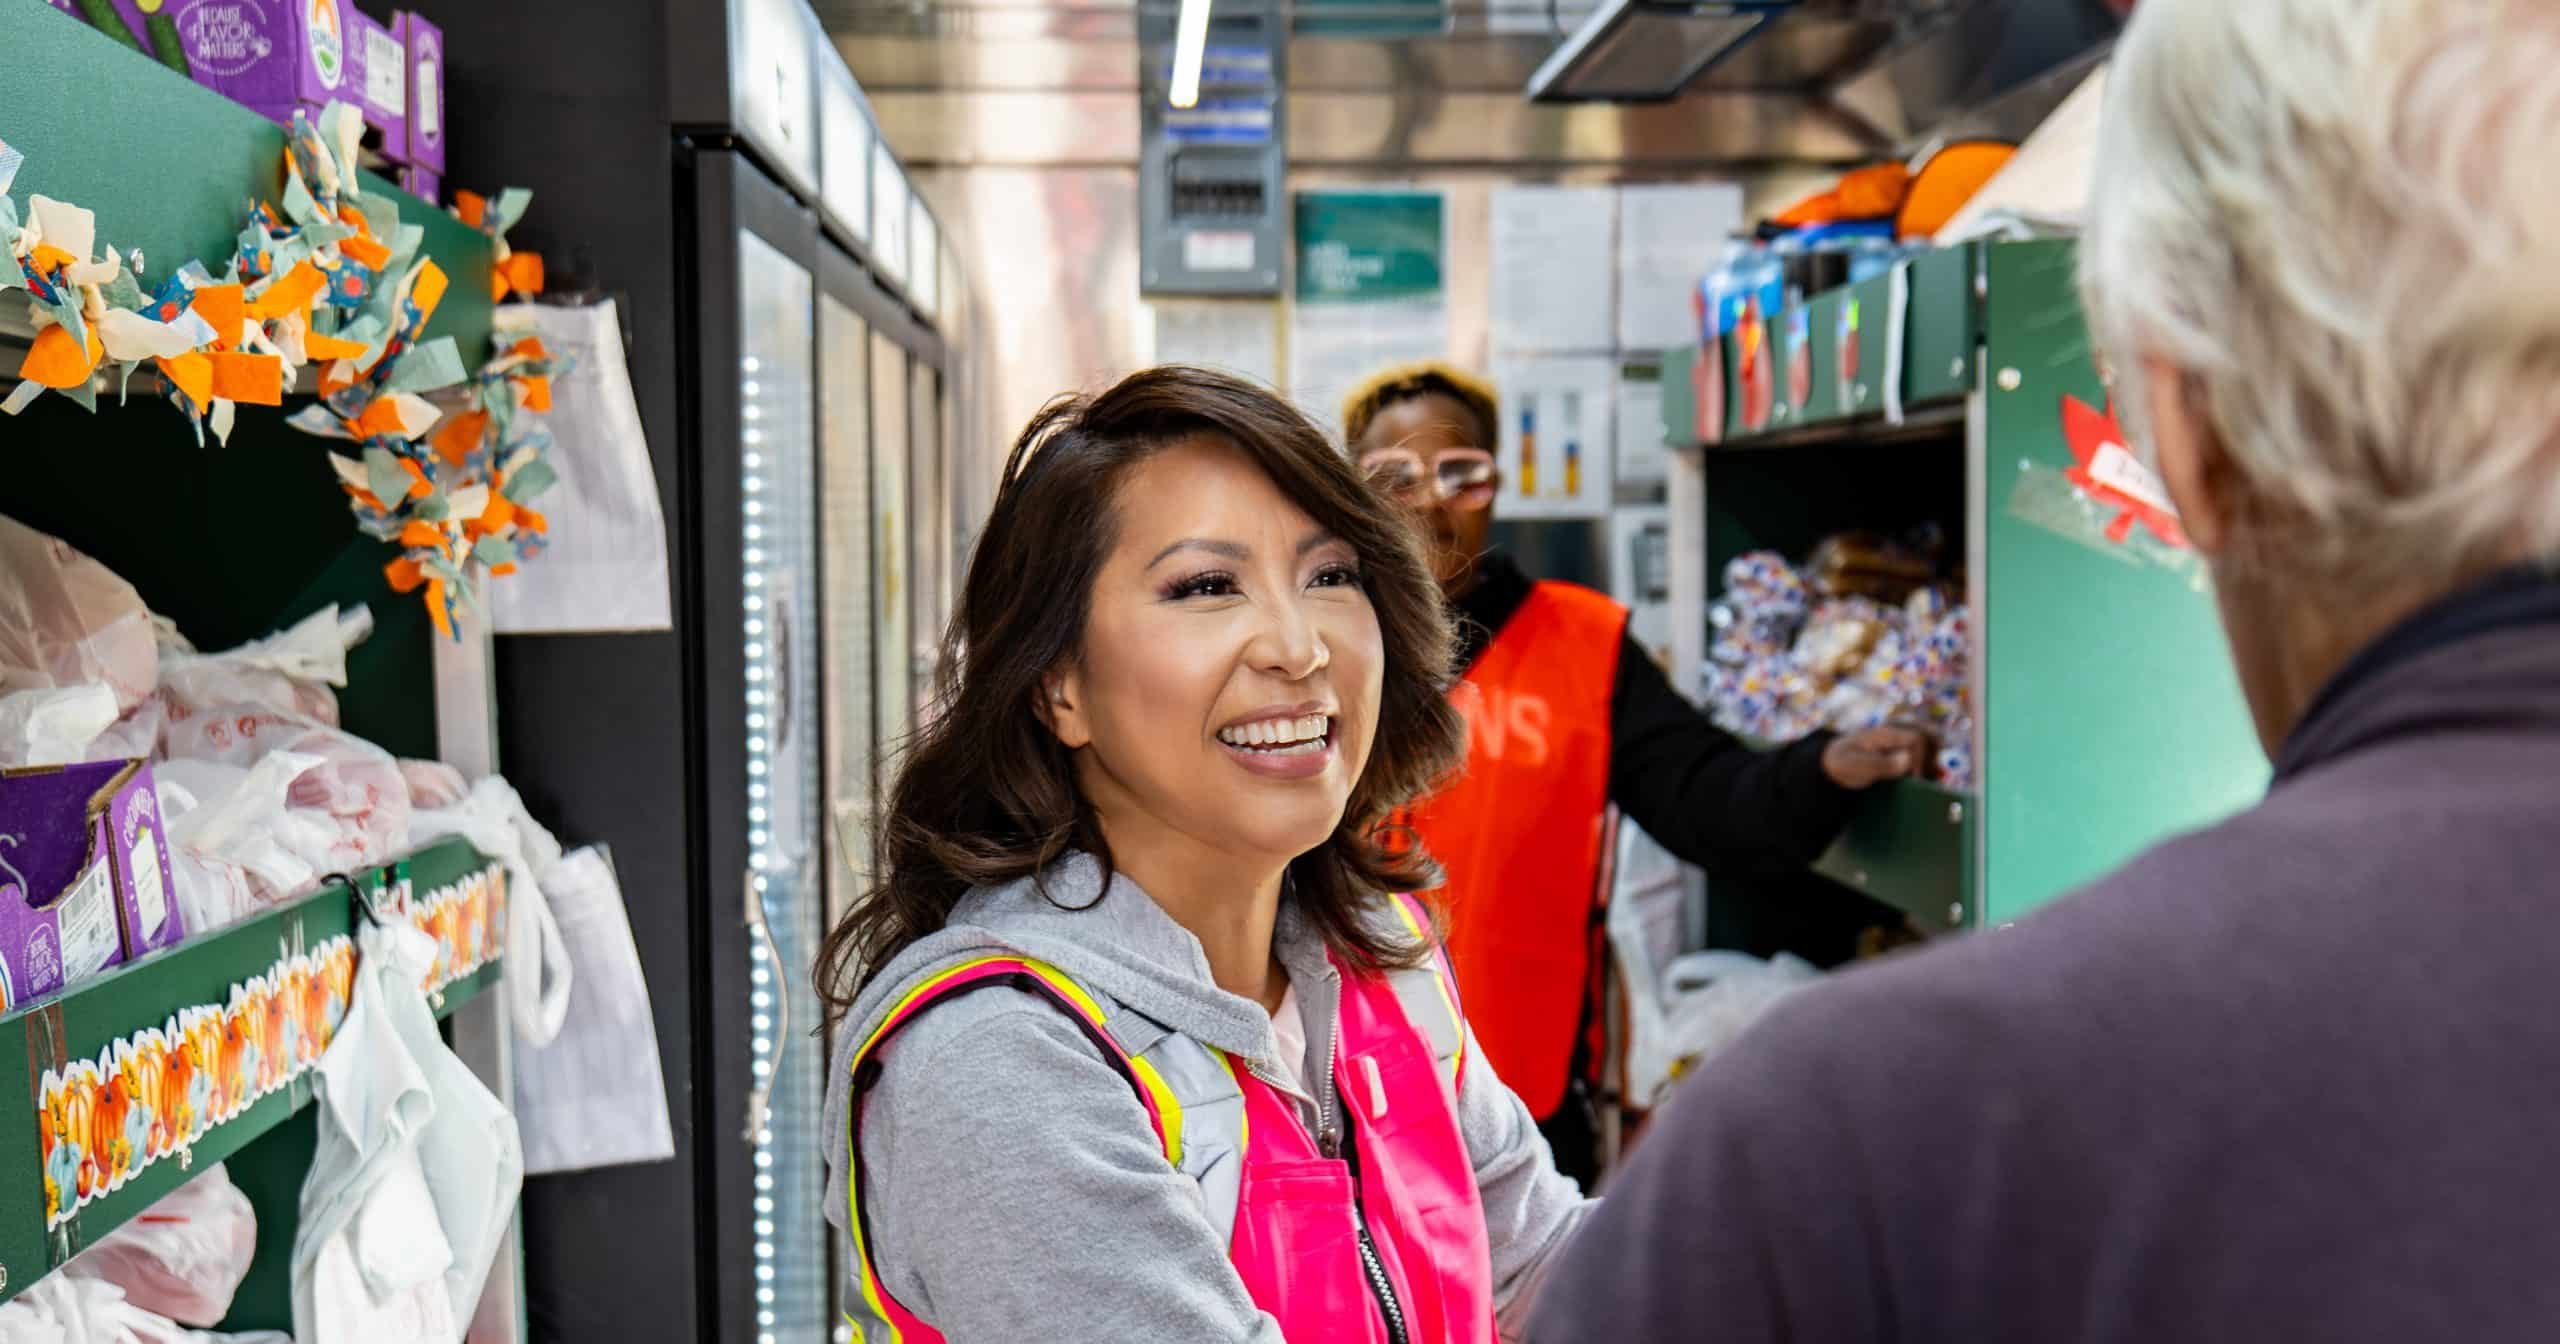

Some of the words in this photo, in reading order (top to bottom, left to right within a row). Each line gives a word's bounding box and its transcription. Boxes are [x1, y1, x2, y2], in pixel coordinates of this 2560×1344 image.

[198, 6, 241, 24] BECAUSE
[190, 22, 253, 42] FLAVOR
[198, 41, 247, 58] MATTERS
[1450, 680, 1550, 766] NS
